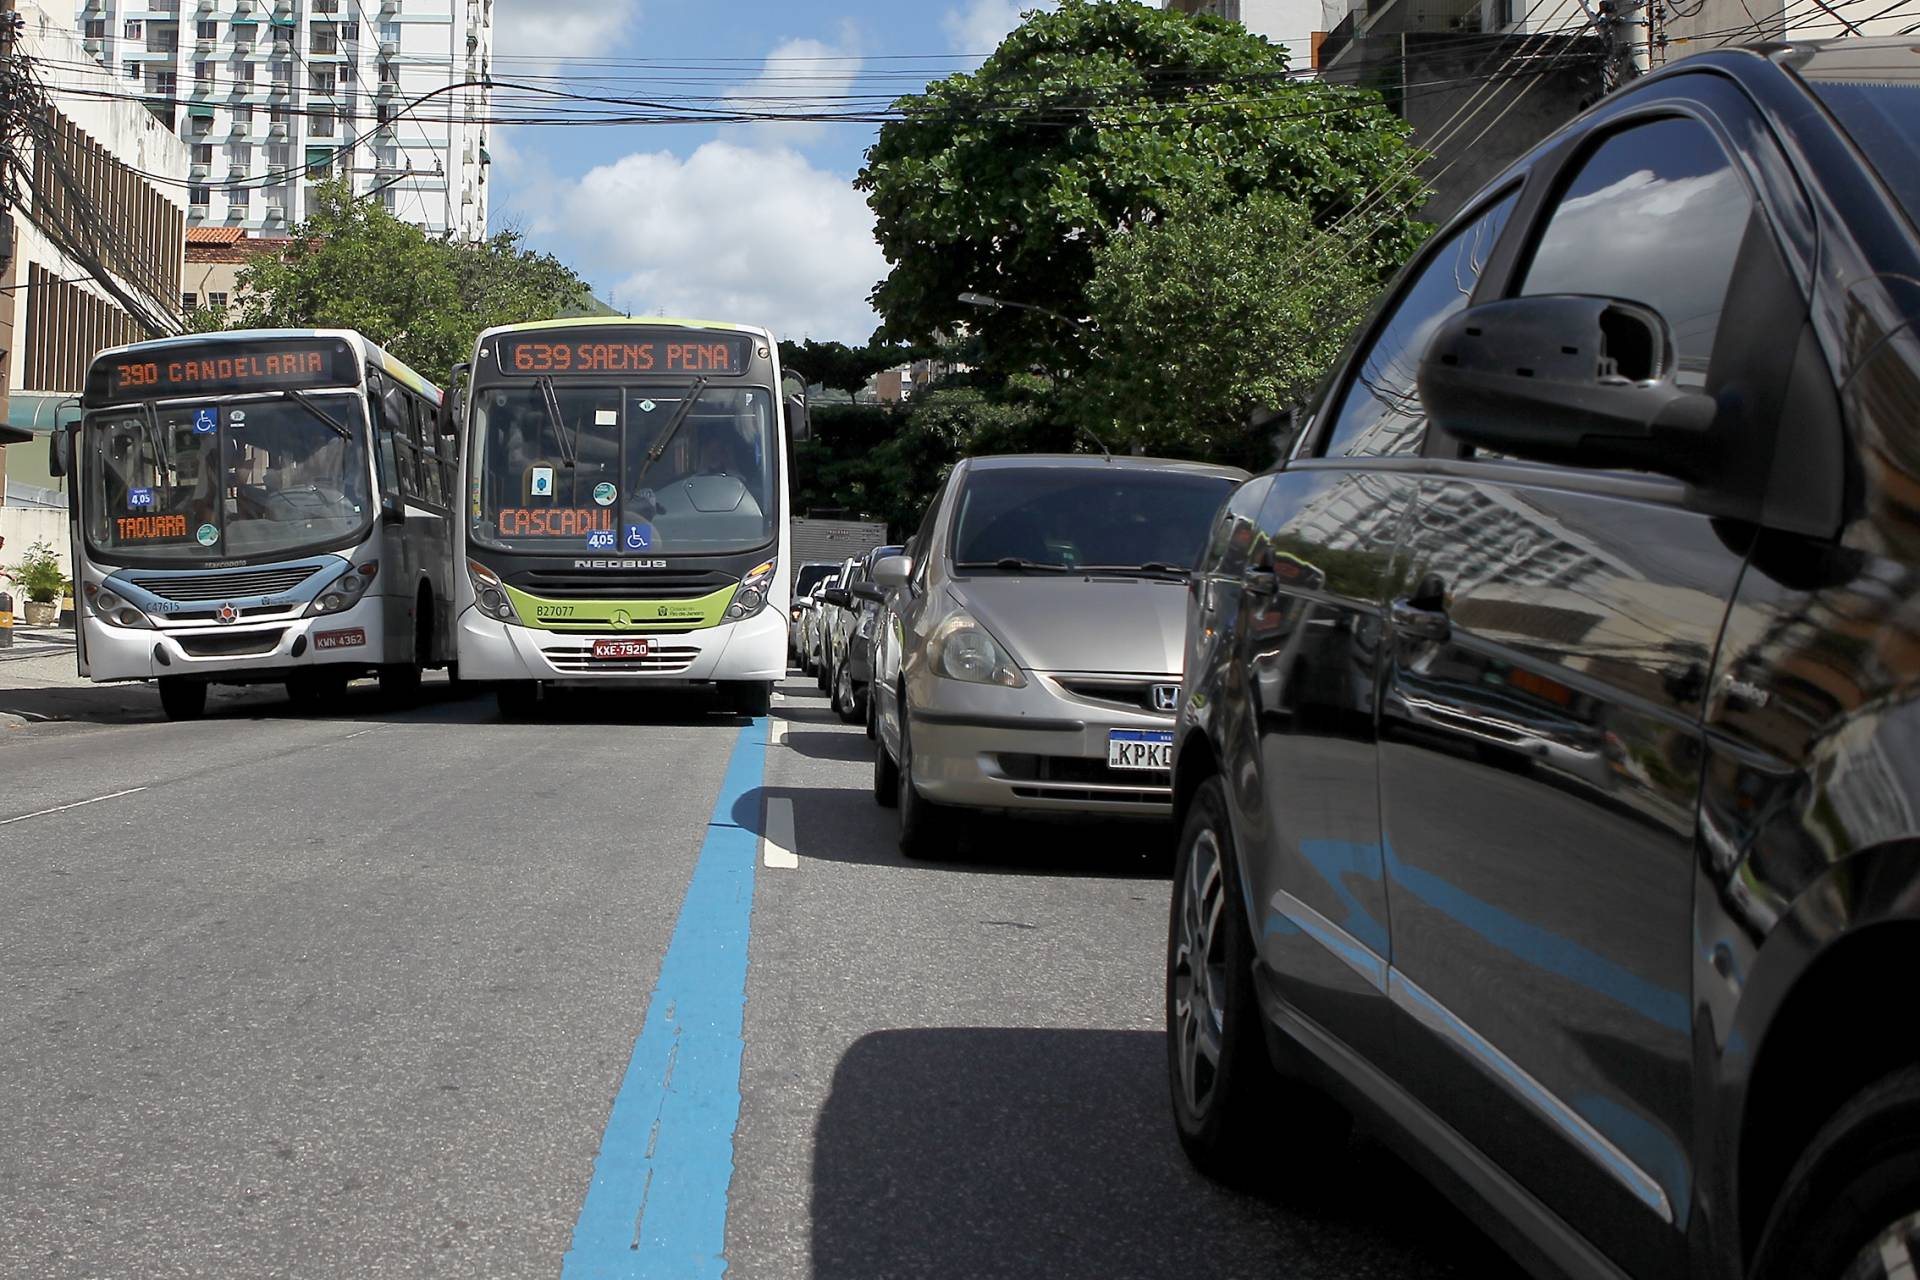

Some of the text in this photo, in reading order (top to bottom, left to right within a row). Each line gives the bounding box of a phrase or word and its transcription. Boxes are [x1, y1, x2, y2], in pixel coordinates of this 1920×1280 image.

[514, 344, 729, 370] 639 SAENS PENA
[117, 352, 322, 387] 390 CANDELARIA
[574, 560, 667, 568] NEOBUS
[145, 601, 181, 613] C47615
[536, 606, 575, 617] B27077
